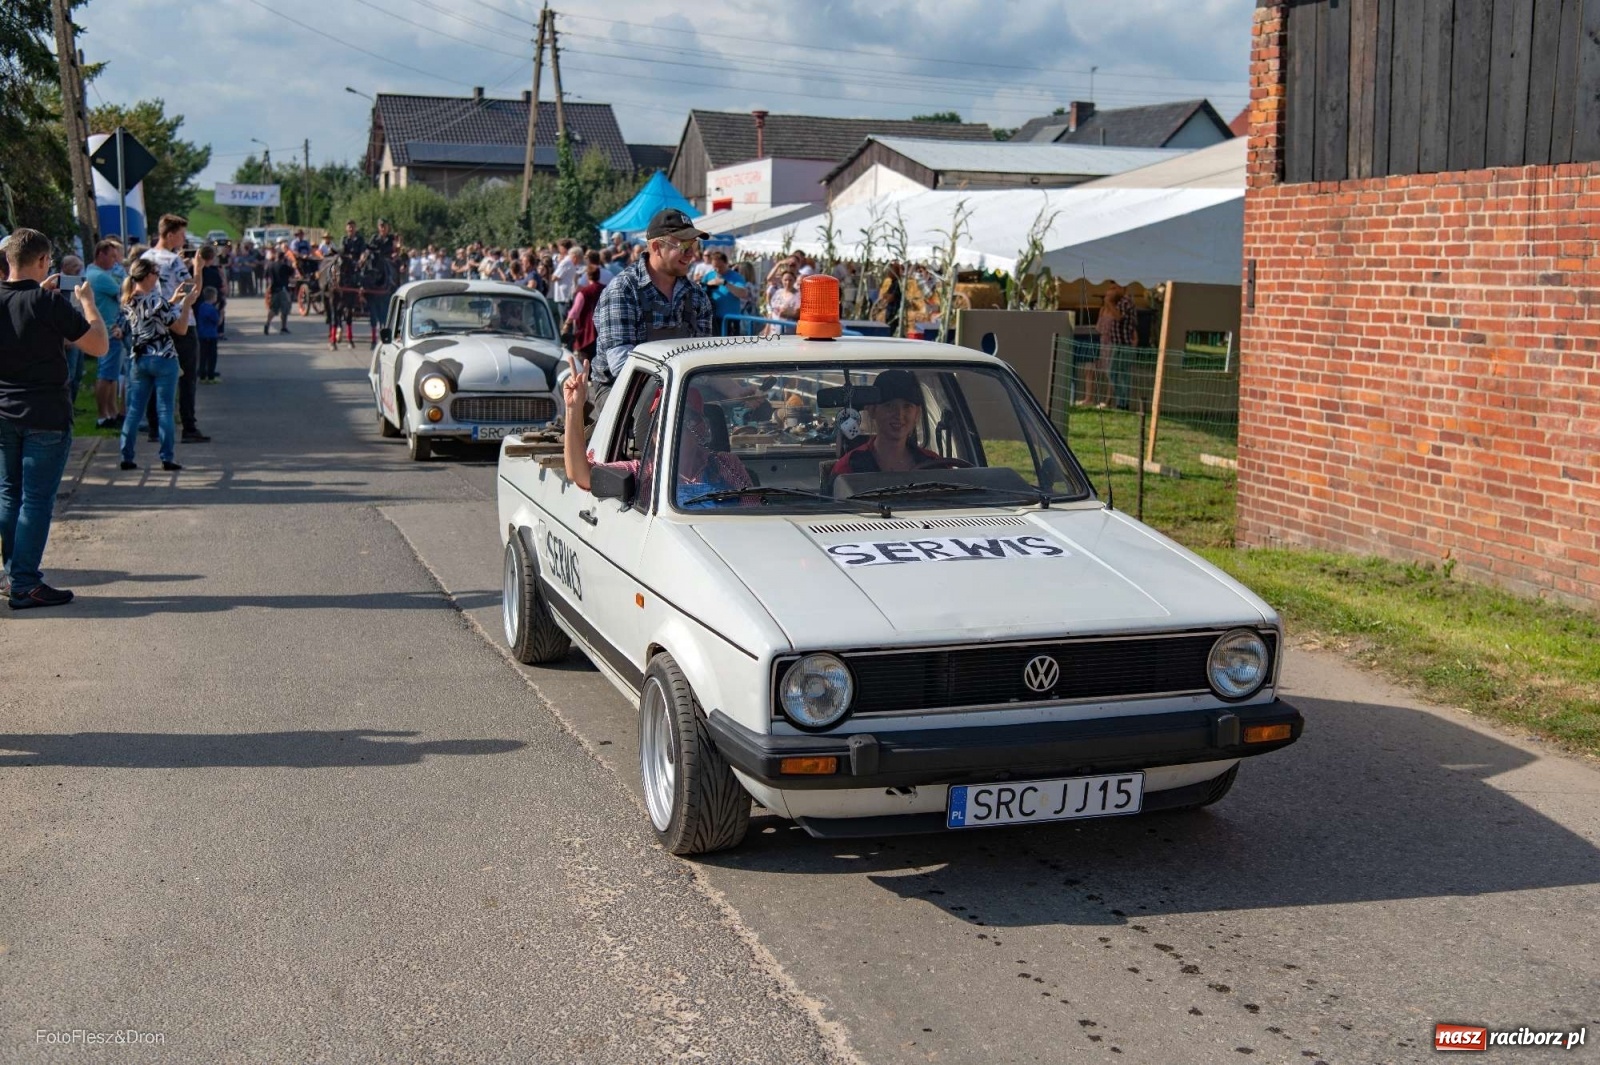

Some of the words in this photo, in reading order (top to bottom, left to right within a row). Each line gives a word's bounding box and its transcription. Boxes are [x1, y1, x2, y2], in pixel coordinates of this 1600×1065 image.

[231, 189, 266, 200] START
[480, 427, 505, 439] SRC
[827, 536, 1064, 565] SERWIS
[547, 530, 582, 601] SERWIS
[1024, 655, 1060, 692] VW
[973, 786, 1039, 821] SRC
[1053, 777, 1133, 815] JJ15
[951, 810, 964, 820] PL
